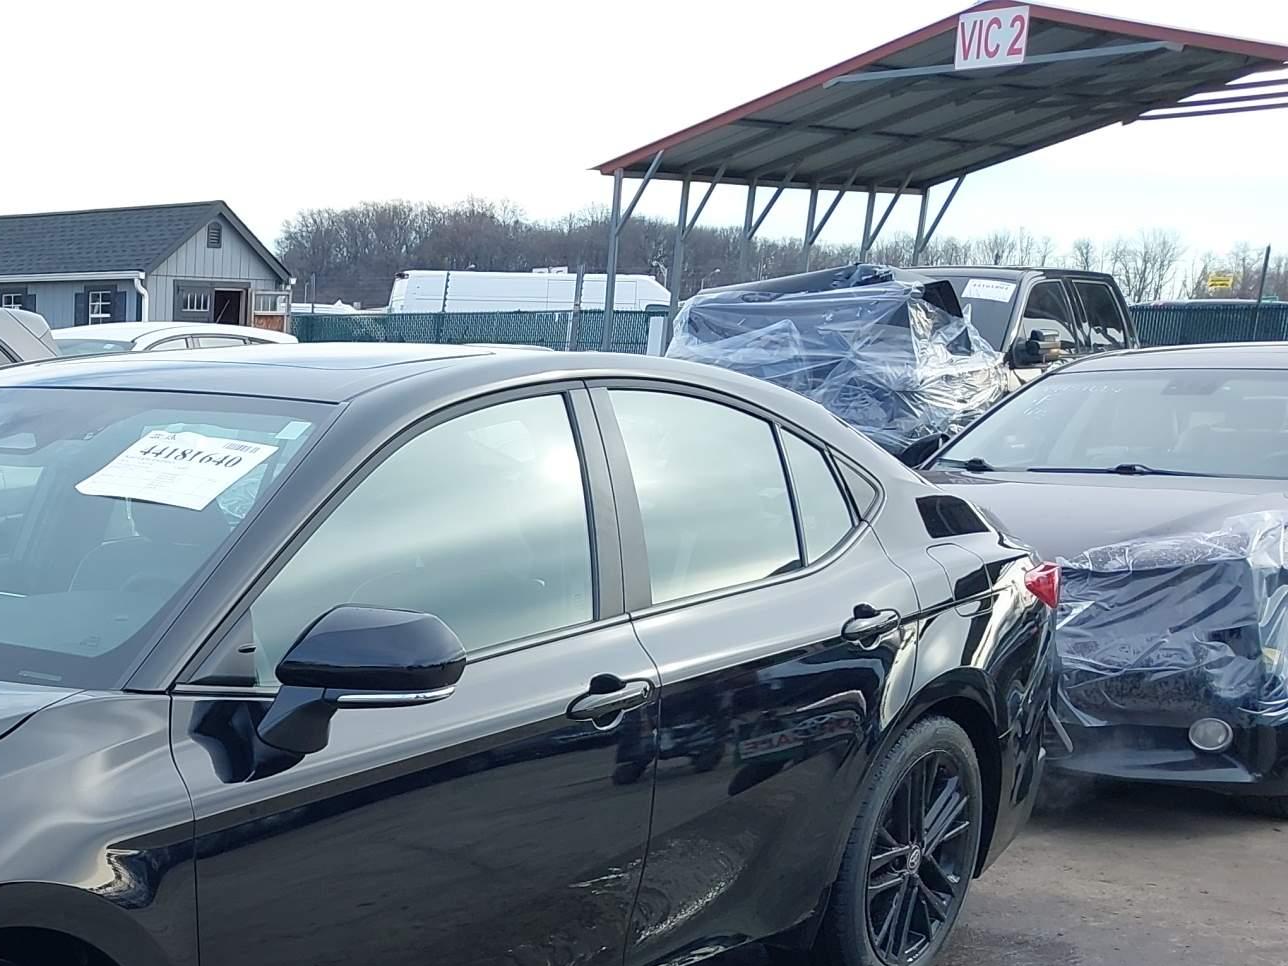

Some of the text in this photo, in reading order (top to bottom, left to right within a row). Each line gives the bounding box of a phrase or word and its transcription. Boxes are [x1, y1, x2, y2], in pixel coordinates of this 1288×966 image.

[961, 14, 1026, 61] VIC 2
[139, 444, 243, 468] 44181640
